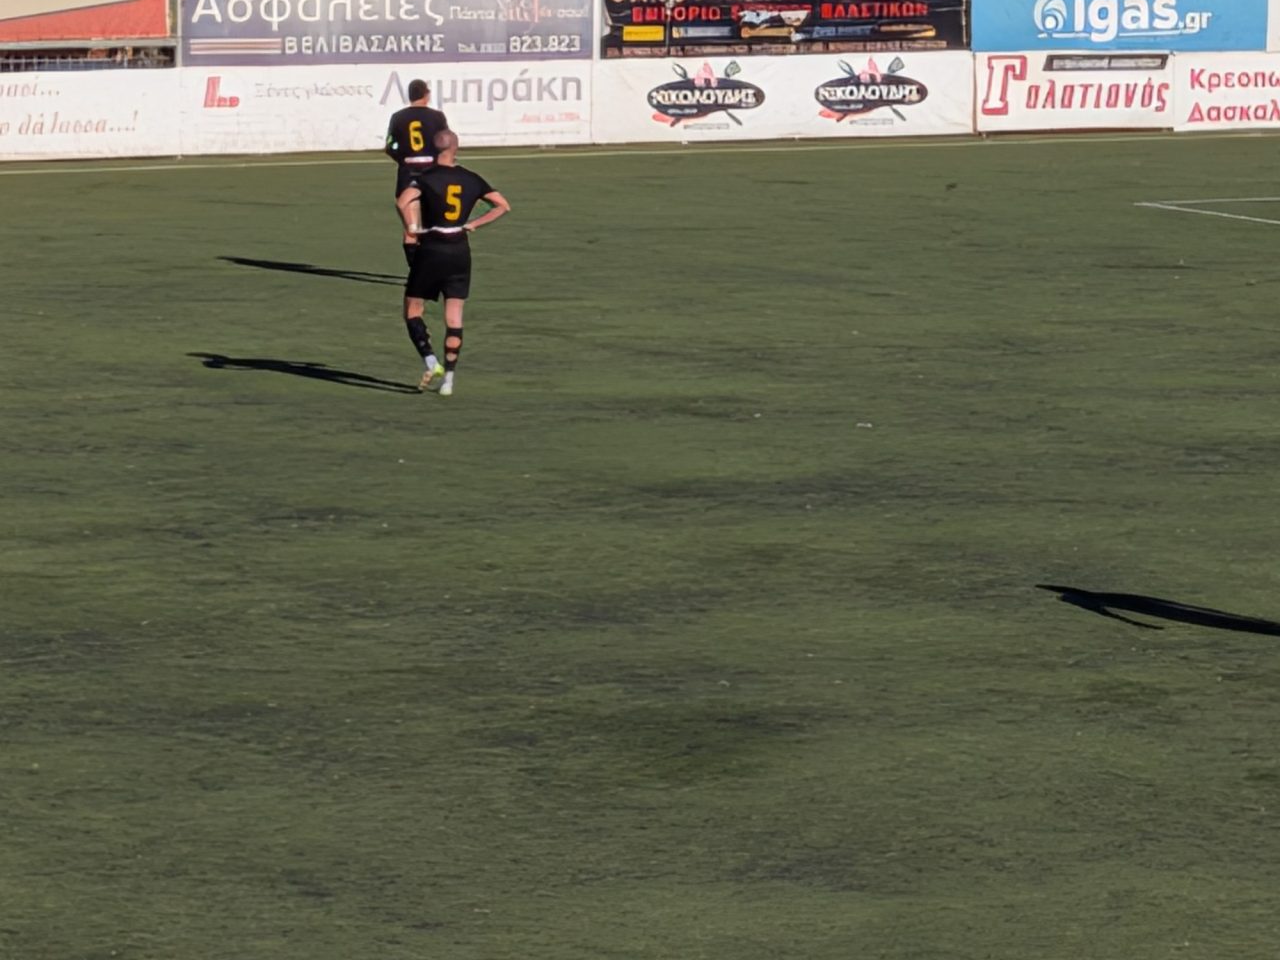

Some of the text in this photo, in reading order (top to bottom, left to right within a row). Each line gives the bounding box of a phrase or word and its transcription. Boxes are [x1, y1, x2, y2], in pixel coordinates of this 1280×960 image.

[285, 34, 445, 54] ΒΕΛΙΒΑΣΑΚΗΣ
[379, 68, 582, 111] Λμπράκη
[409, 120, 425, 152] 6
[444, 185, 462, 221] 5
